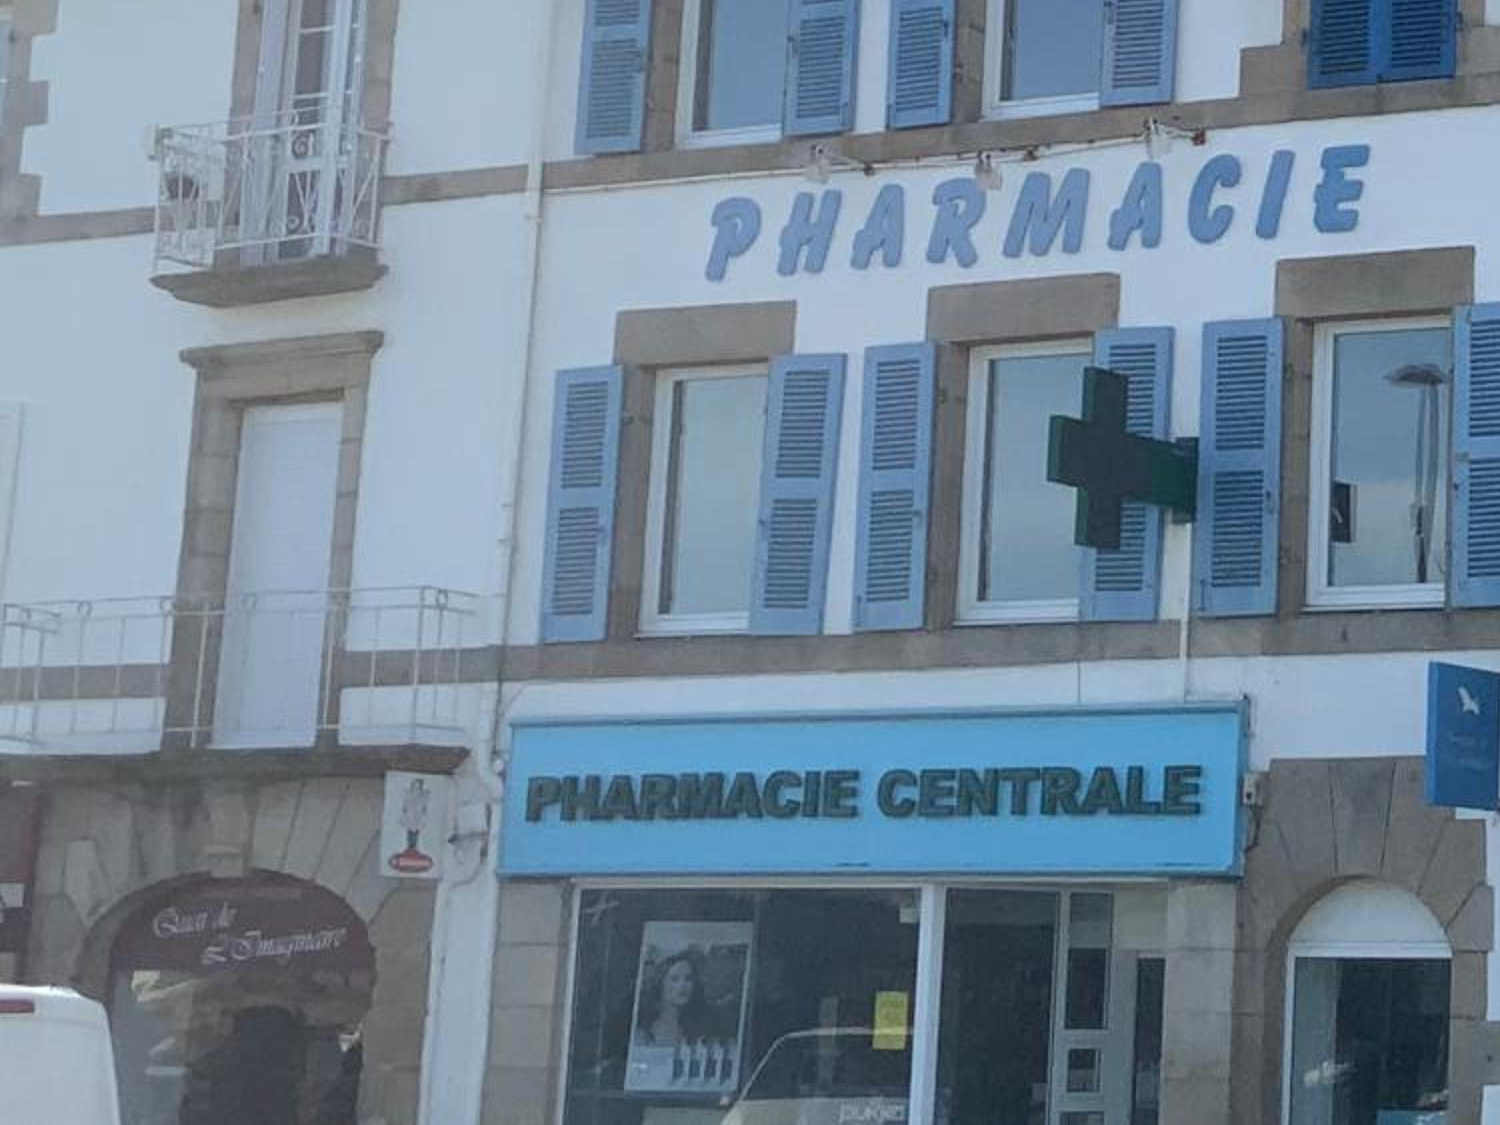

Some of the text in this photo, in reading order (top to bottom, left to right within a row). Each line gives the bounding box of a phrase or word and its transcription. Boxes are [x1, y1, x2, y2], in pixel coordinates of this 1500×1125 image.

[705, 143, 1371, 282] PHARMACIE
[525, 765, 1202, 822] PHARMACIE CENTRALE
